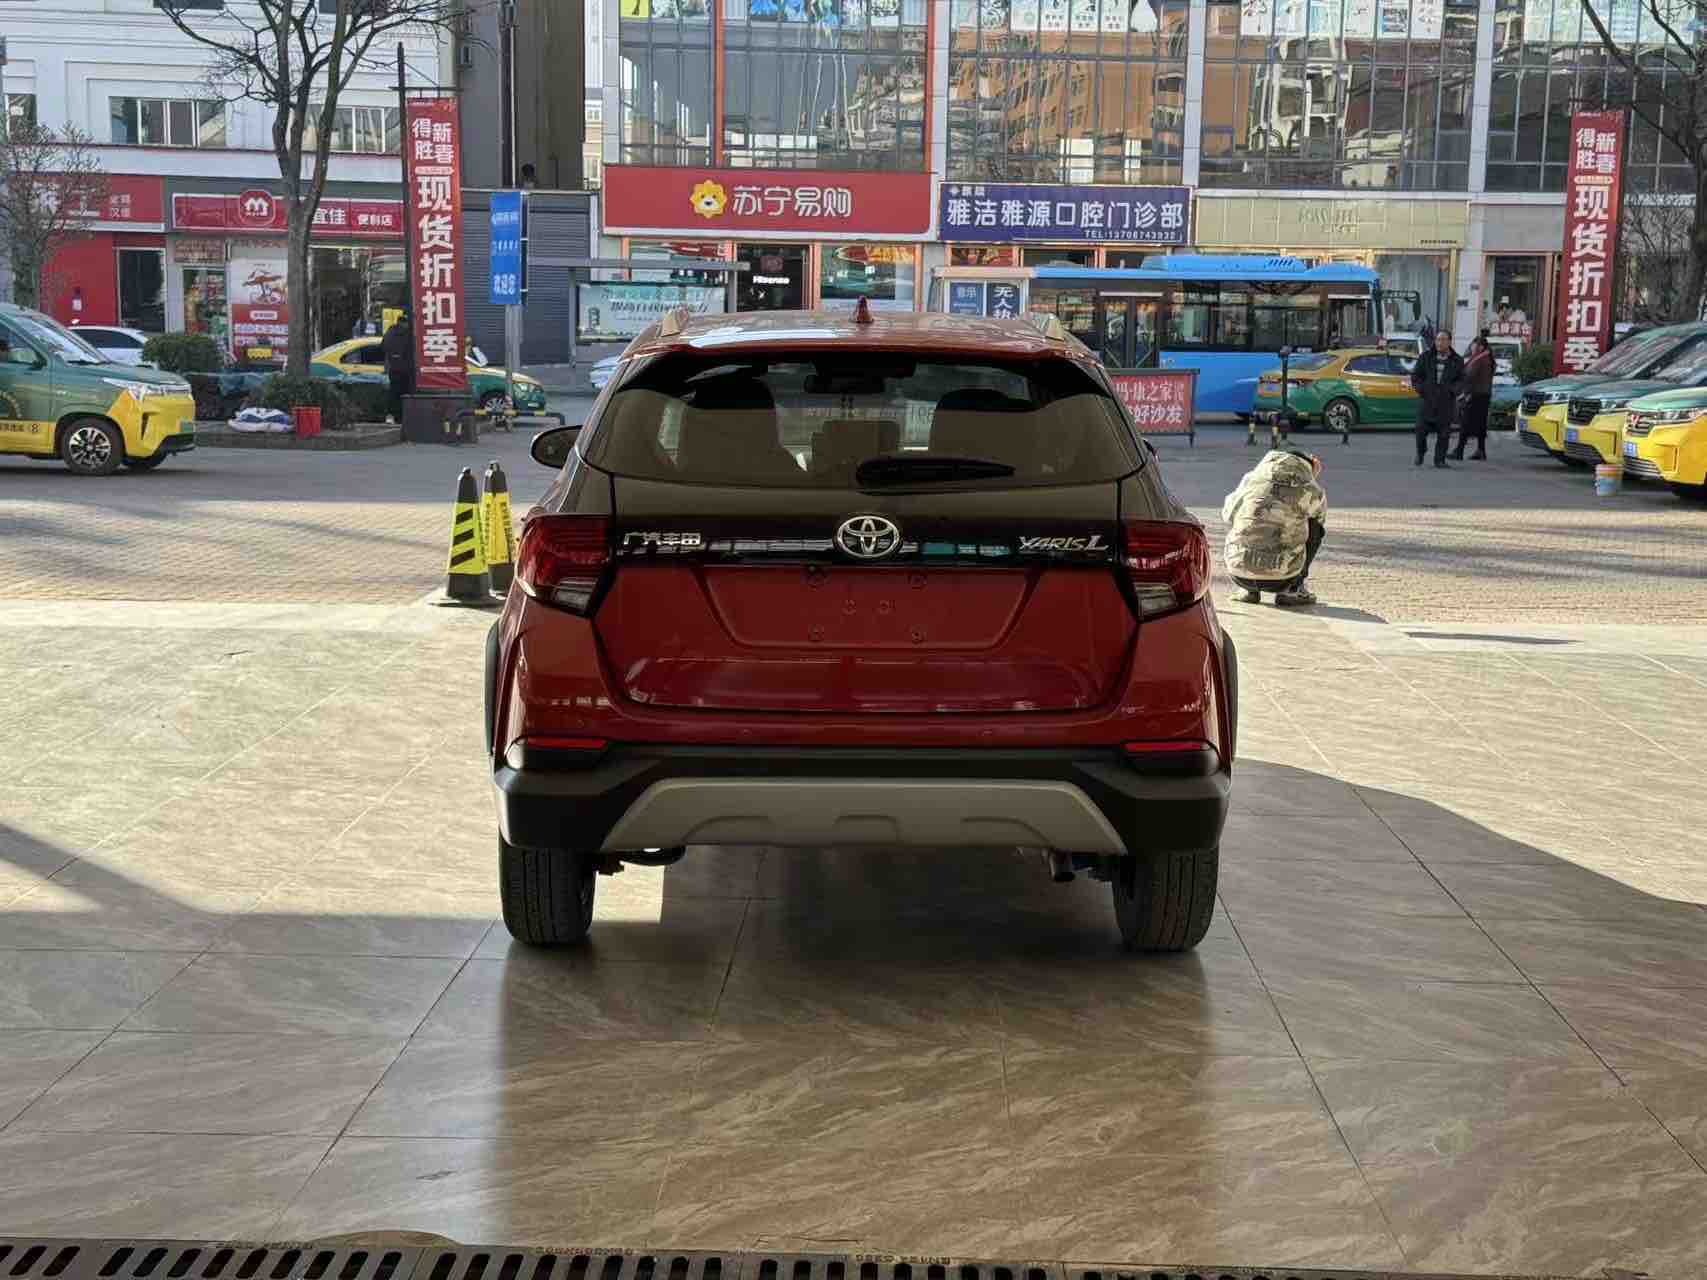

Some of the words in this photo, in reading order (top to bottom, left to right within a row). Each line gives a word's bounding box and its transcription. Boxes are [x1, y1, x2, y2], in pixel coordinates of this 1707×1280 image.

[412, 117, 433, 161] 得胜
[432, 122, 454, 164] 新春
[1575, 127, 1596, 170] 得胜
[1596, 131, 1617, 174] 新春
[732, 185, 852, 217] 苏宁易购
[946, 199, 1184, 229] 雅洁雅源口腔门诊部
[417, 175, 458, 363] 现货折扣季
[1562, 185, 1610, 371] 现货折扣季
[623, 531, 701, 546] 广汽丰田
